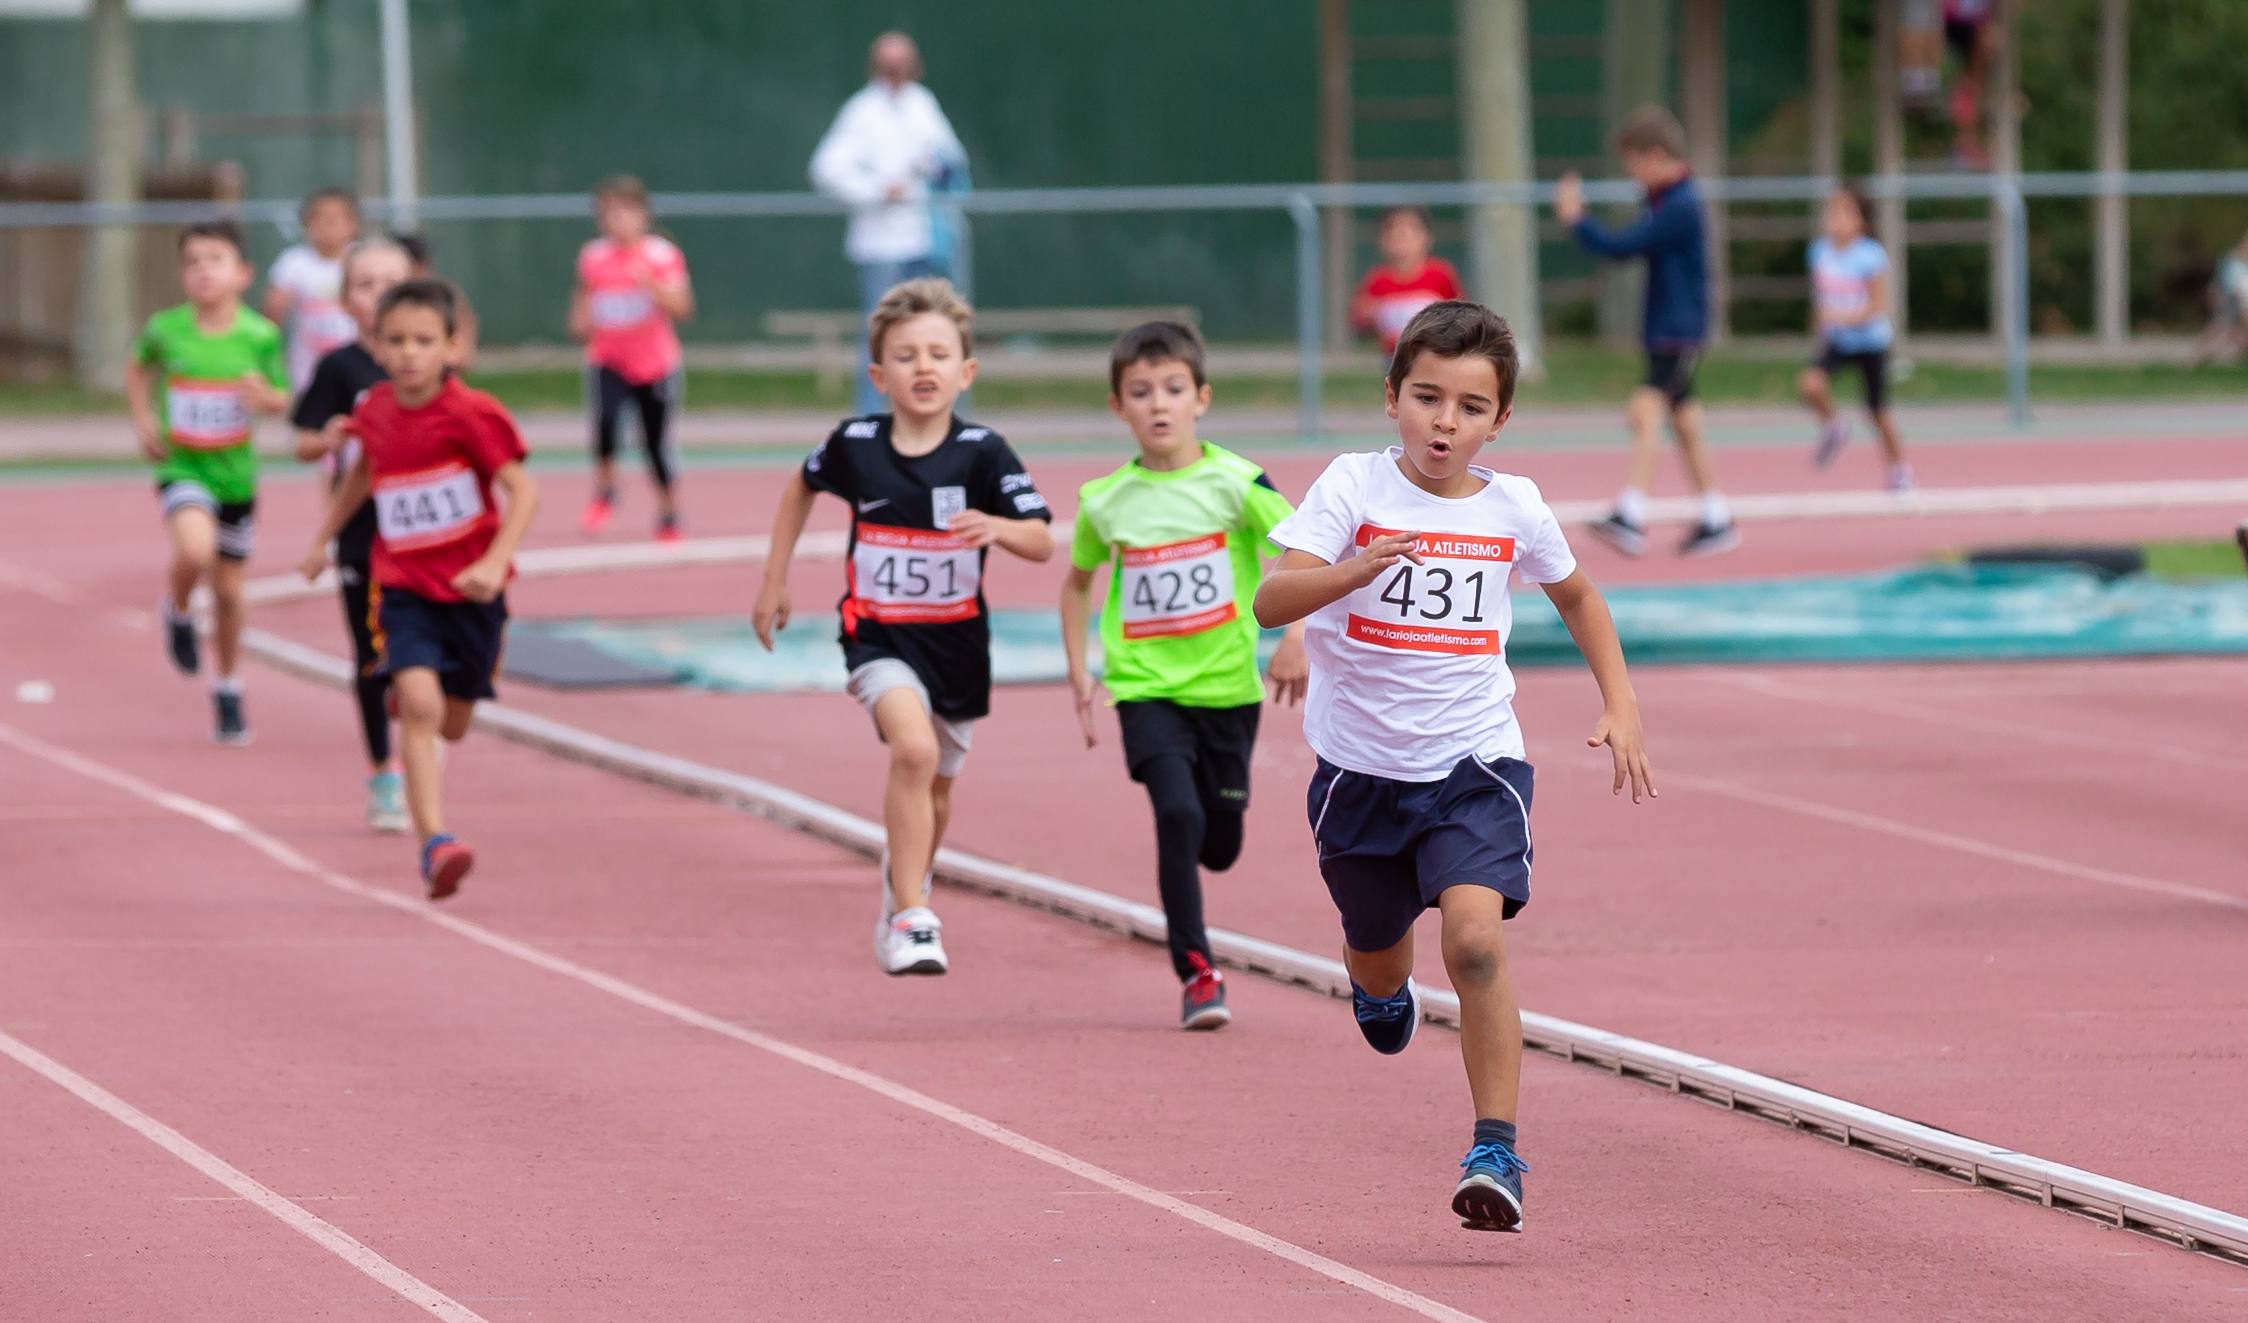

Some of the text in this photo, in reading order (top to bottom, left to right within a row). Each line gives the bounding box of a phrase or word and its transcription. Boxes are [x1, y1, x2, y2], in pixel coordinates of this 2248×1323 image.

[391, 487, 465, 529] 441
[1433, 540, 1501, 558] ATLETISMO
[872, 555, 960, 598] 451
[1133, 563, 1219, 613] 428
[1380, 565, 1483, 623] 431
[1360, 623, 1487, 646] www.lariojaatletismo.com
